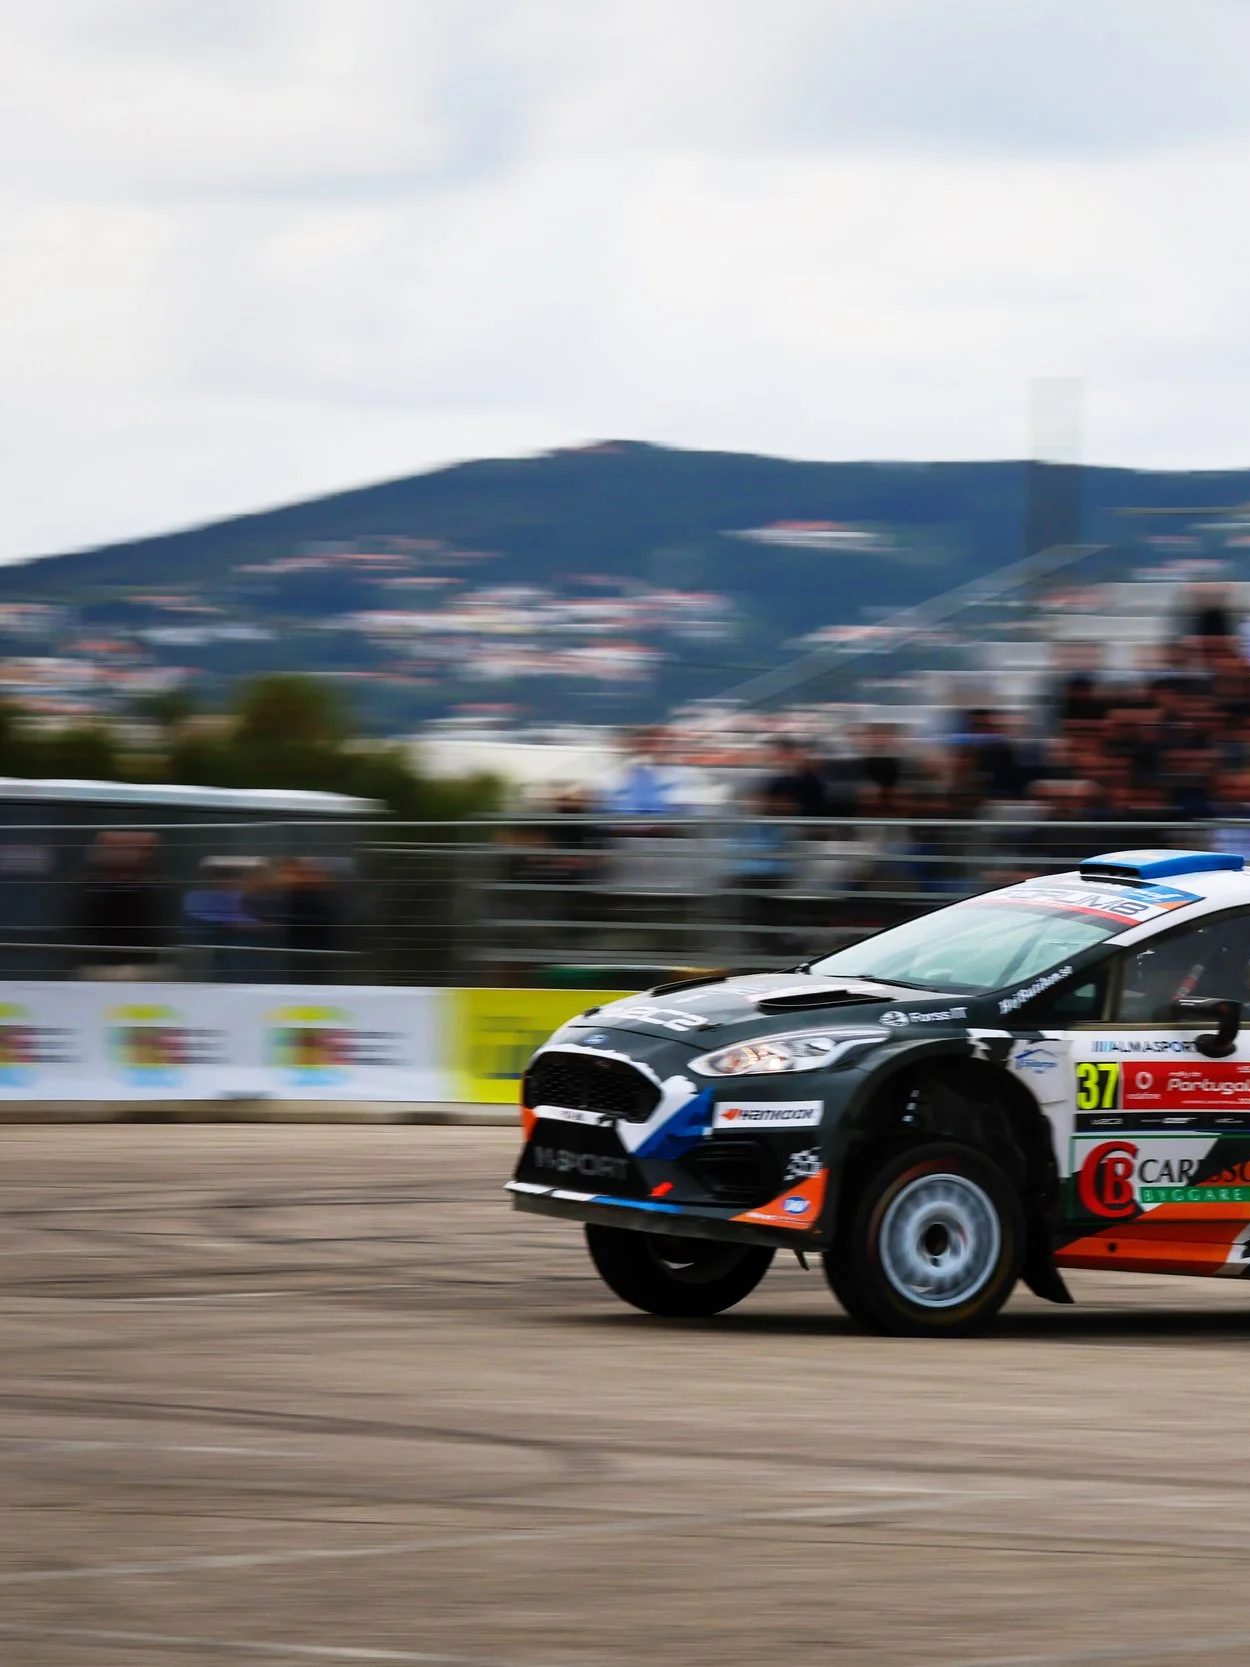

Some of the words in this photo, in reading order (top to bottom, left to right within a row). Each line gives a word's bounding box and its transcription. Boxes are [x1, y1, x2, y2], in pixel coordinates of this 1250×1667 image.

[909, 1012, 950, 1023] Forss
[1076, 1062, 1119, 1110] 37
[1143, 1189, 1243, 1202] BYGGARE
